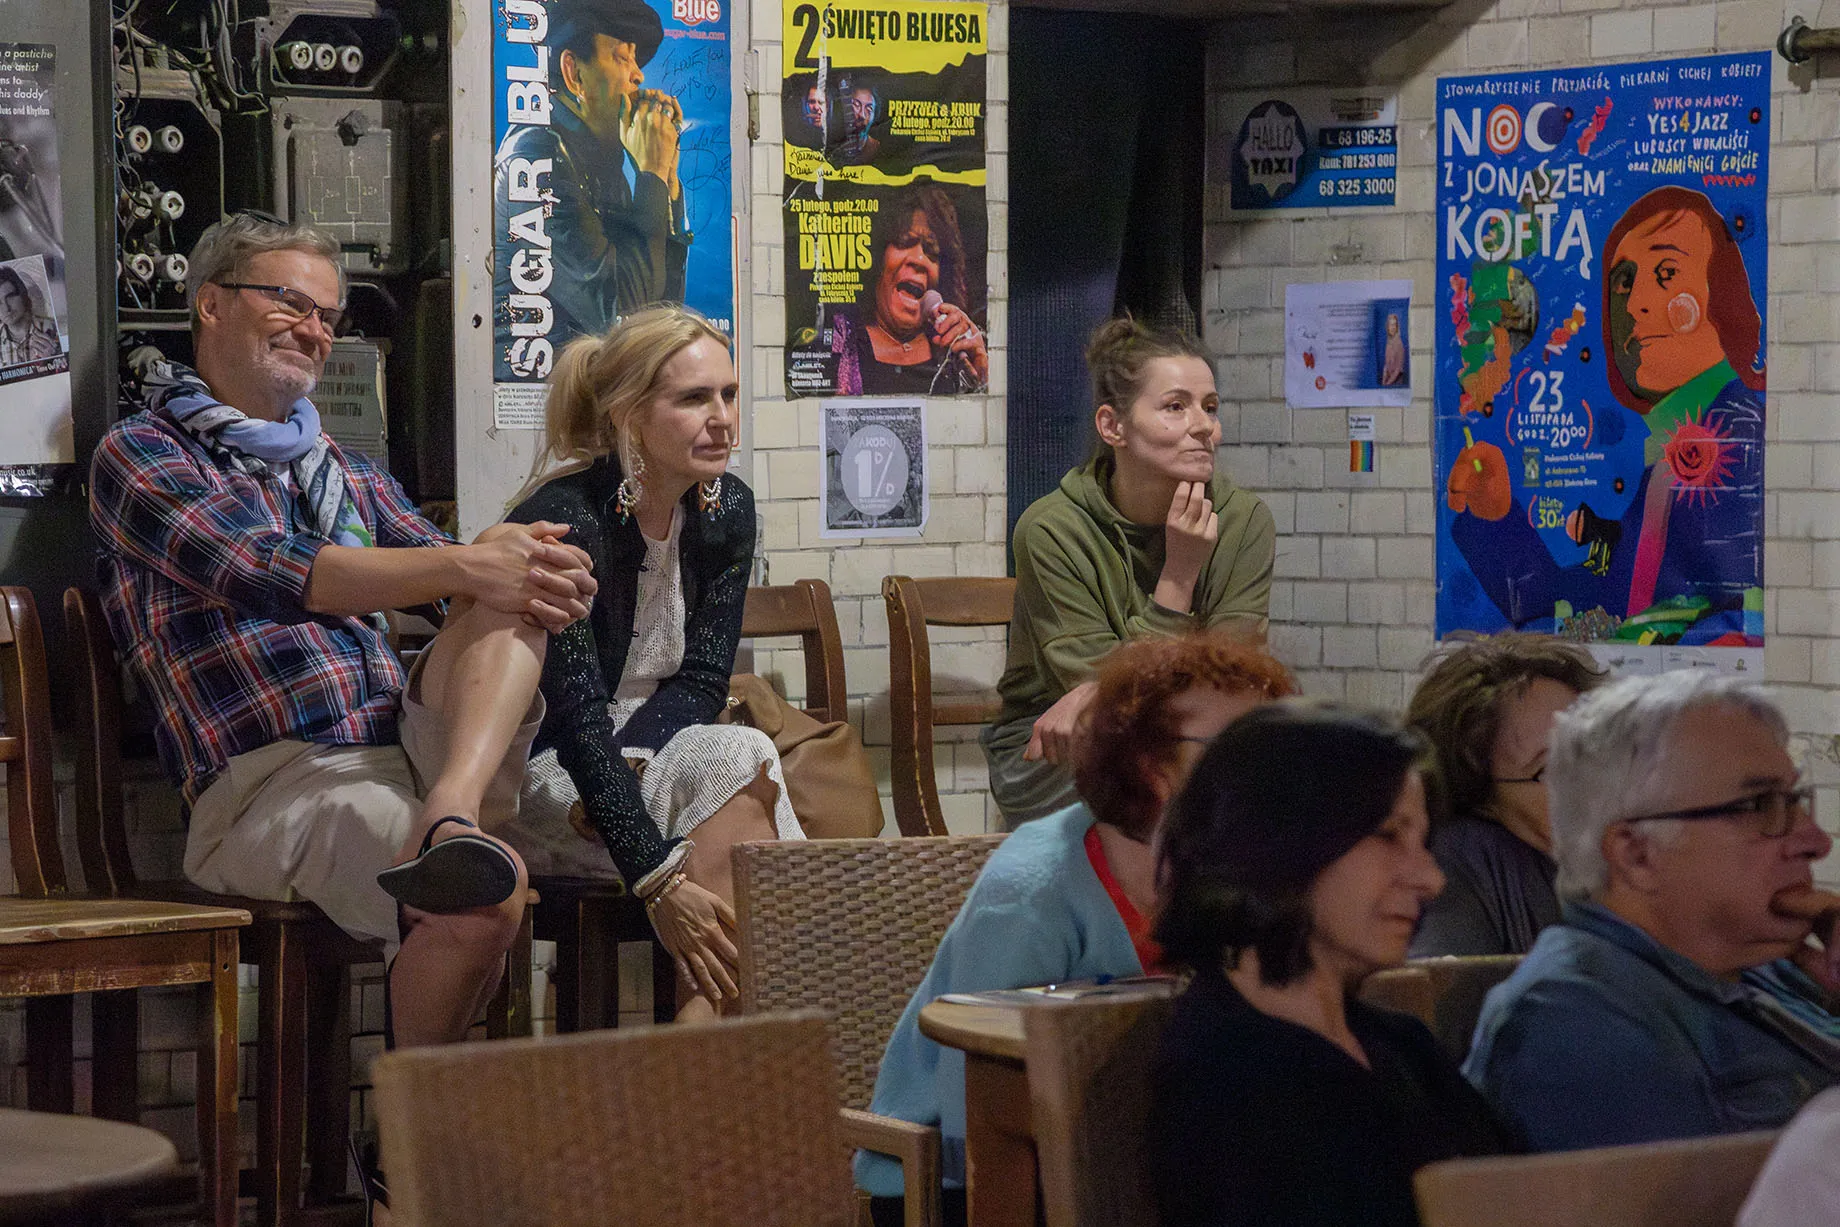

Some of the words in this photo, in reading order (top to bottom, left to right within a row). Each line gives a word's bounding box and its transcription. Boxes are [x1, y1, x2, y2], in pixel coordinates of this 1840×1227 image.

[792, 3, 832, 68] 2
[822, 3, 900, 46] ŚWIĘTO
[906, 12, 981, 44] BLUESA
[14, 48, 54, 60] pastiche
[14, 62, 39, 72] artist
[12, 75, 22, 84] to
[1444, 79, 1541, 99] STOWARZYSZENIE
[1551, 71, 1611, 93] PRZYJACIÓŁ
[1620, 67, 1669, 89] PIEKARNI
[1678, 67, 1712, 81] CICHEJ
[1721, 63, 1762, 78] KOBIETY
[1356, 128, 1392, 145] 196-25
[1443, 101, 1561, 157] NOC
[1634, 137, 1687, 156] LUBUSCY
[1692, 128, 1749, 151] WOKALIŚCI
[1250, 157, 1294, 175] TAXI
[1319, 180, 1335, 196] 68
[1337, 179, 1361, 196] 325
[1363, 178, 1394, 195] 3000
[1459, 159, 1605, 204] JONASZEM
[790, 199, 802, 213] 25
[798, 212, 872, 233] Katherine
[799, 233, 873, 270] DAVIS
[1446, 203, 1593, 280] KOFTĄ
[505, 156, 557, 379] SUGAR
[1528, 370, 1564, 413] 23
[1517, 412, 1574, 426] LISTOPADA
